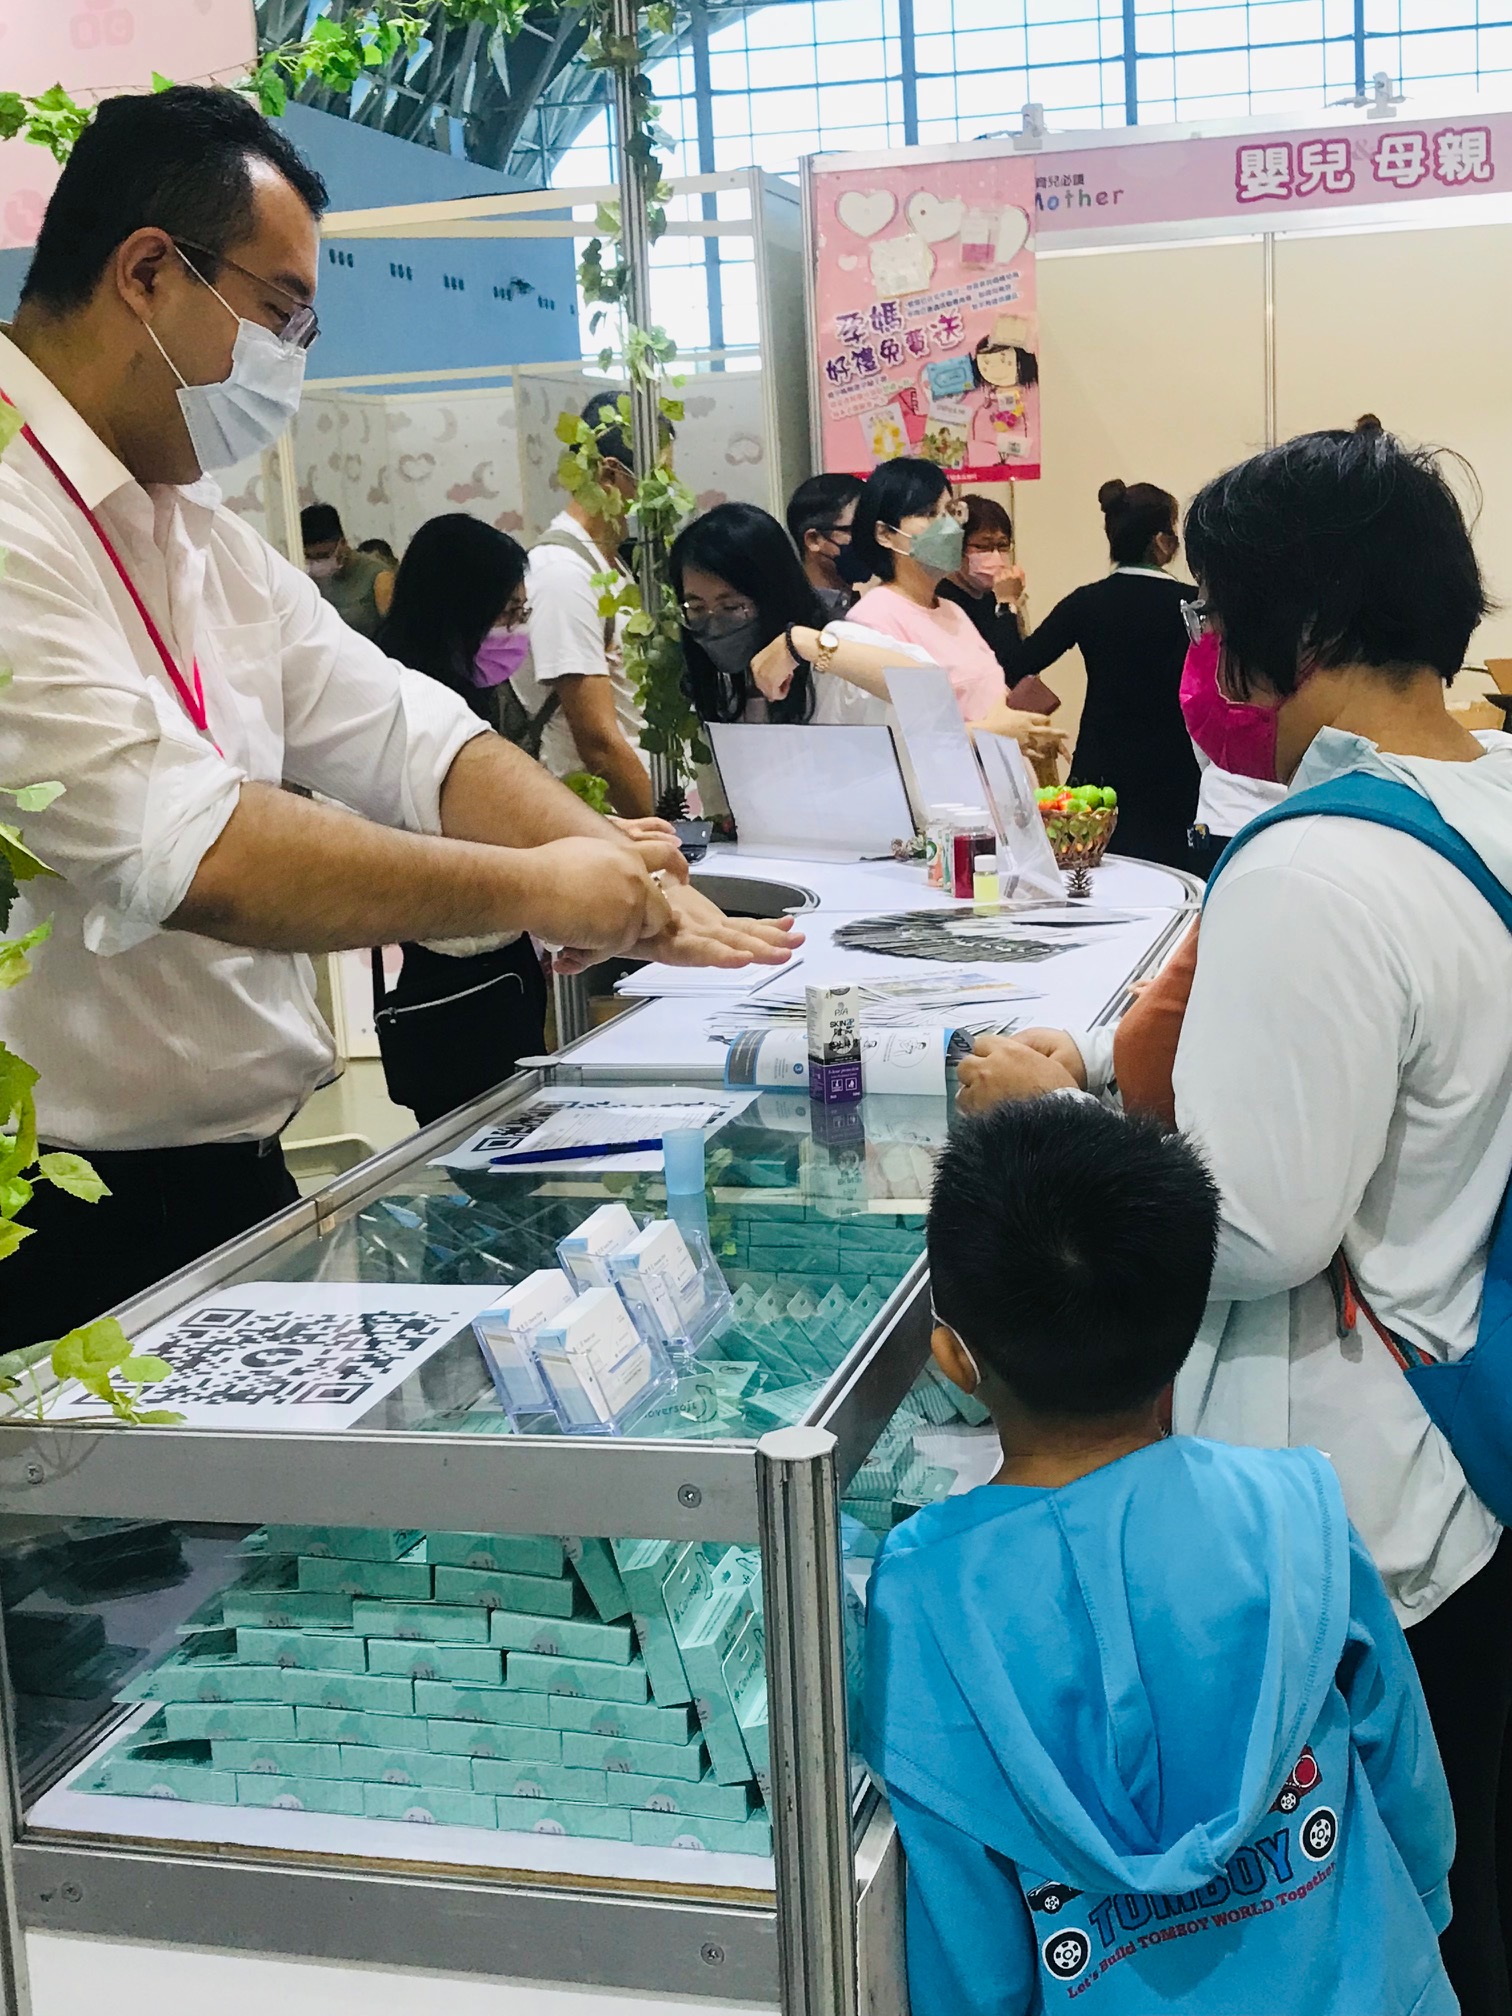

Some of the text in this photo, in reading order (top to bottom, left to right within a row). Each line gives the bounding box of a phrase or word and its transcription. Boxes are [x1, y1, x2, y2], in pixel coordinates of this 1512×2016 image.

[1099, 1940, 1137, 1973] Build
[1211, 1899, 1275, 1928] WORLD
[1275, 1861, 1337, 1906] Together
